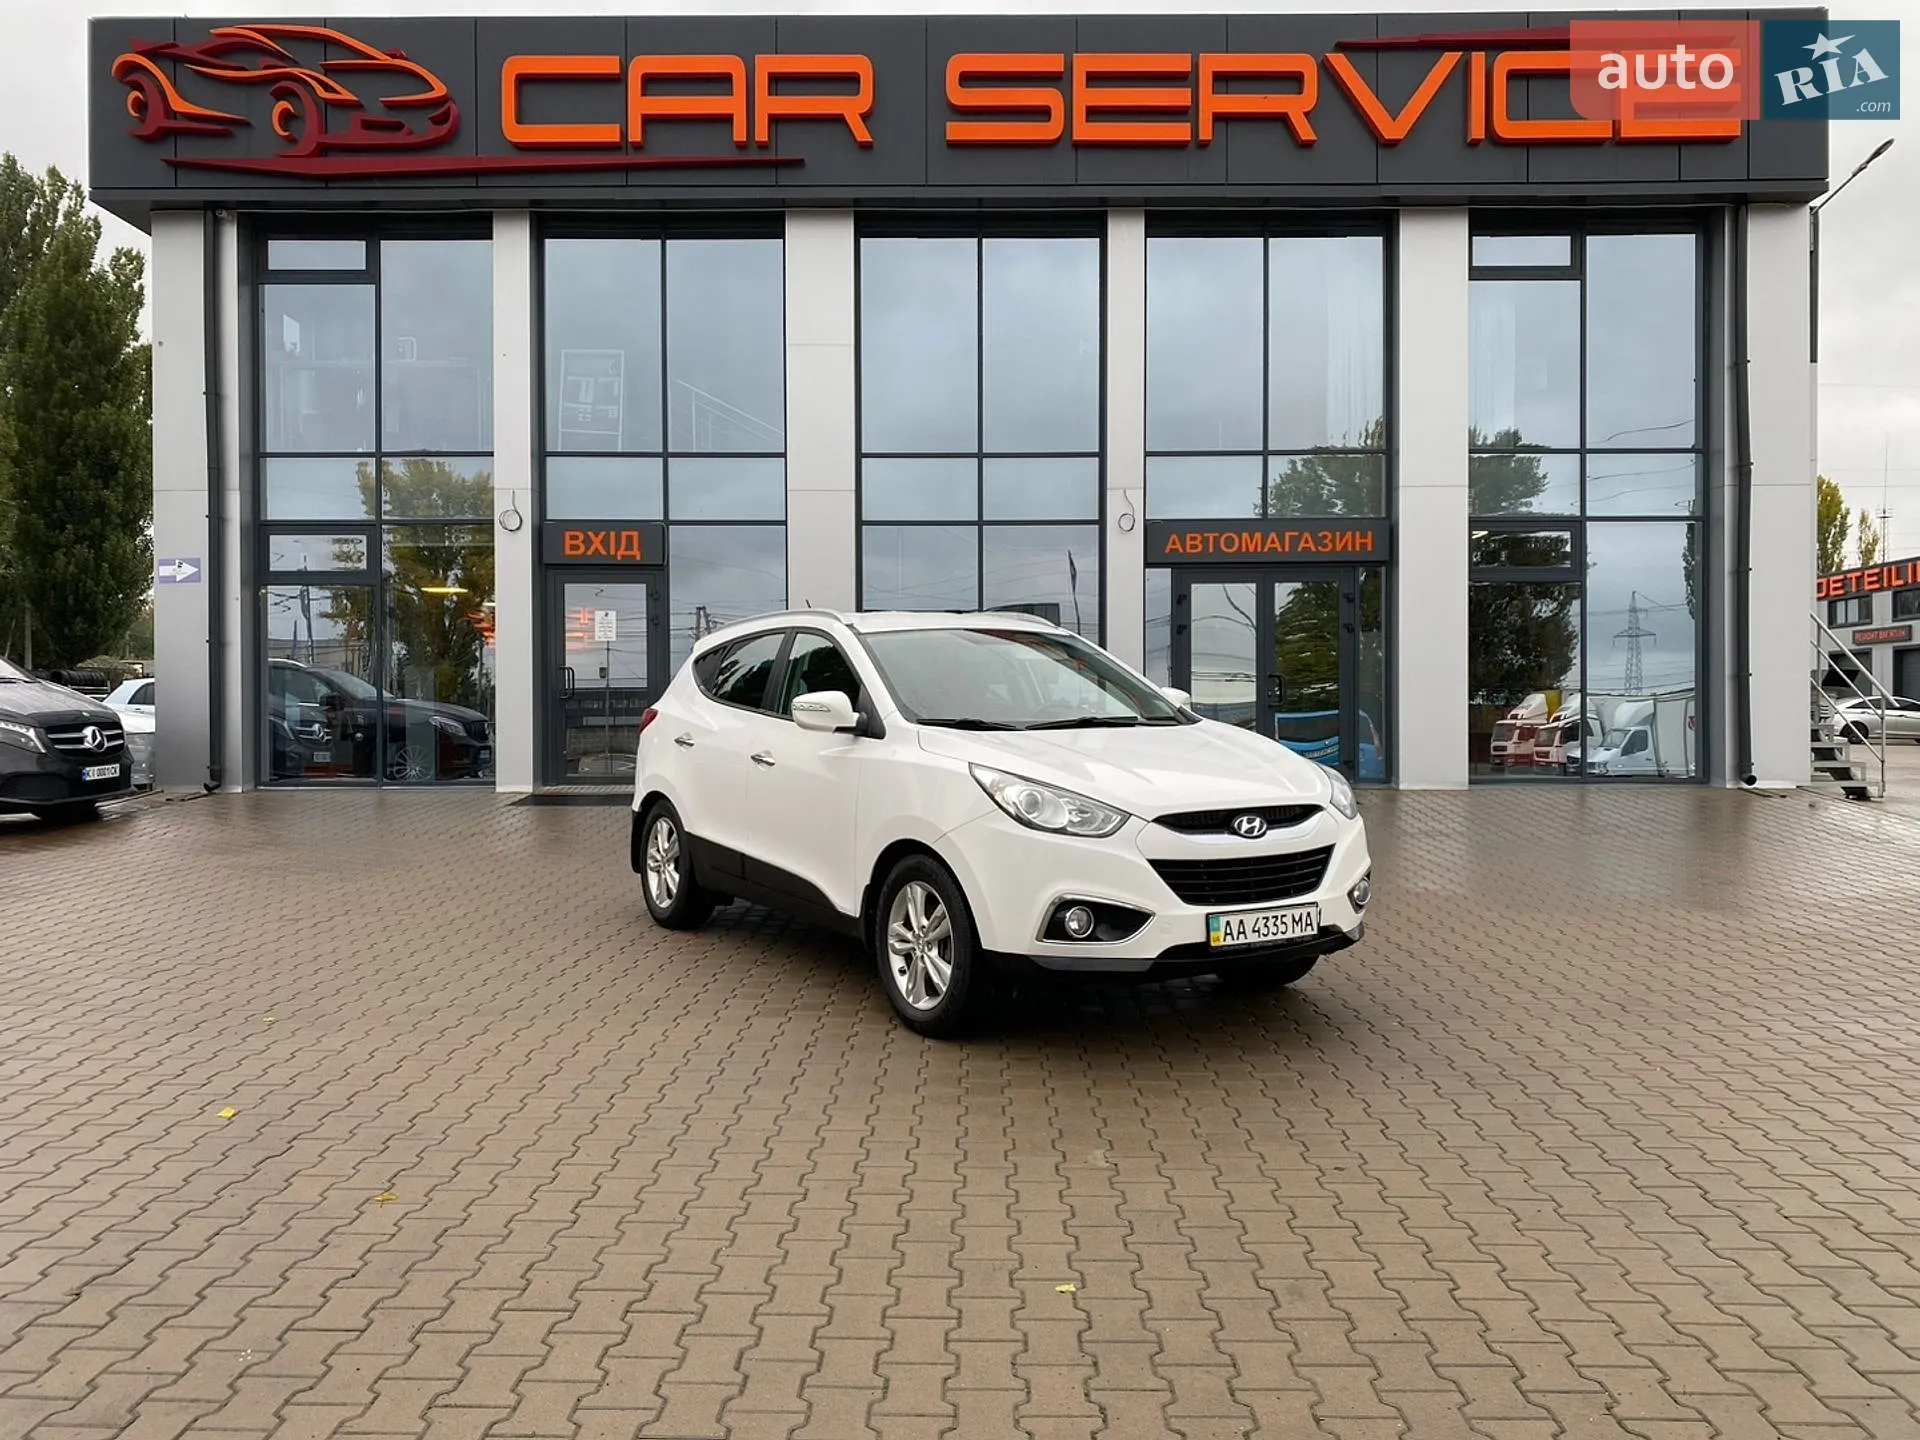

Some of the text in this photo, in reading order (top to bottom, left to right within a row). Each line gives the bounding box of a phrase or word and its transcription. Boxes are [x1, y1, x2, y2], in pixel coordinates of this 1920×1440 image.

[501, 50, 1742, 147] CAR SERVICE
[564, 530, 641, 560] ВХІД
[1165, 531, 1374, 553] АВТОМАГАЗИН
[1816, 560, 1920, 600] DETEILI
[1223, 911, 1314, 941] AA 4335 MA
